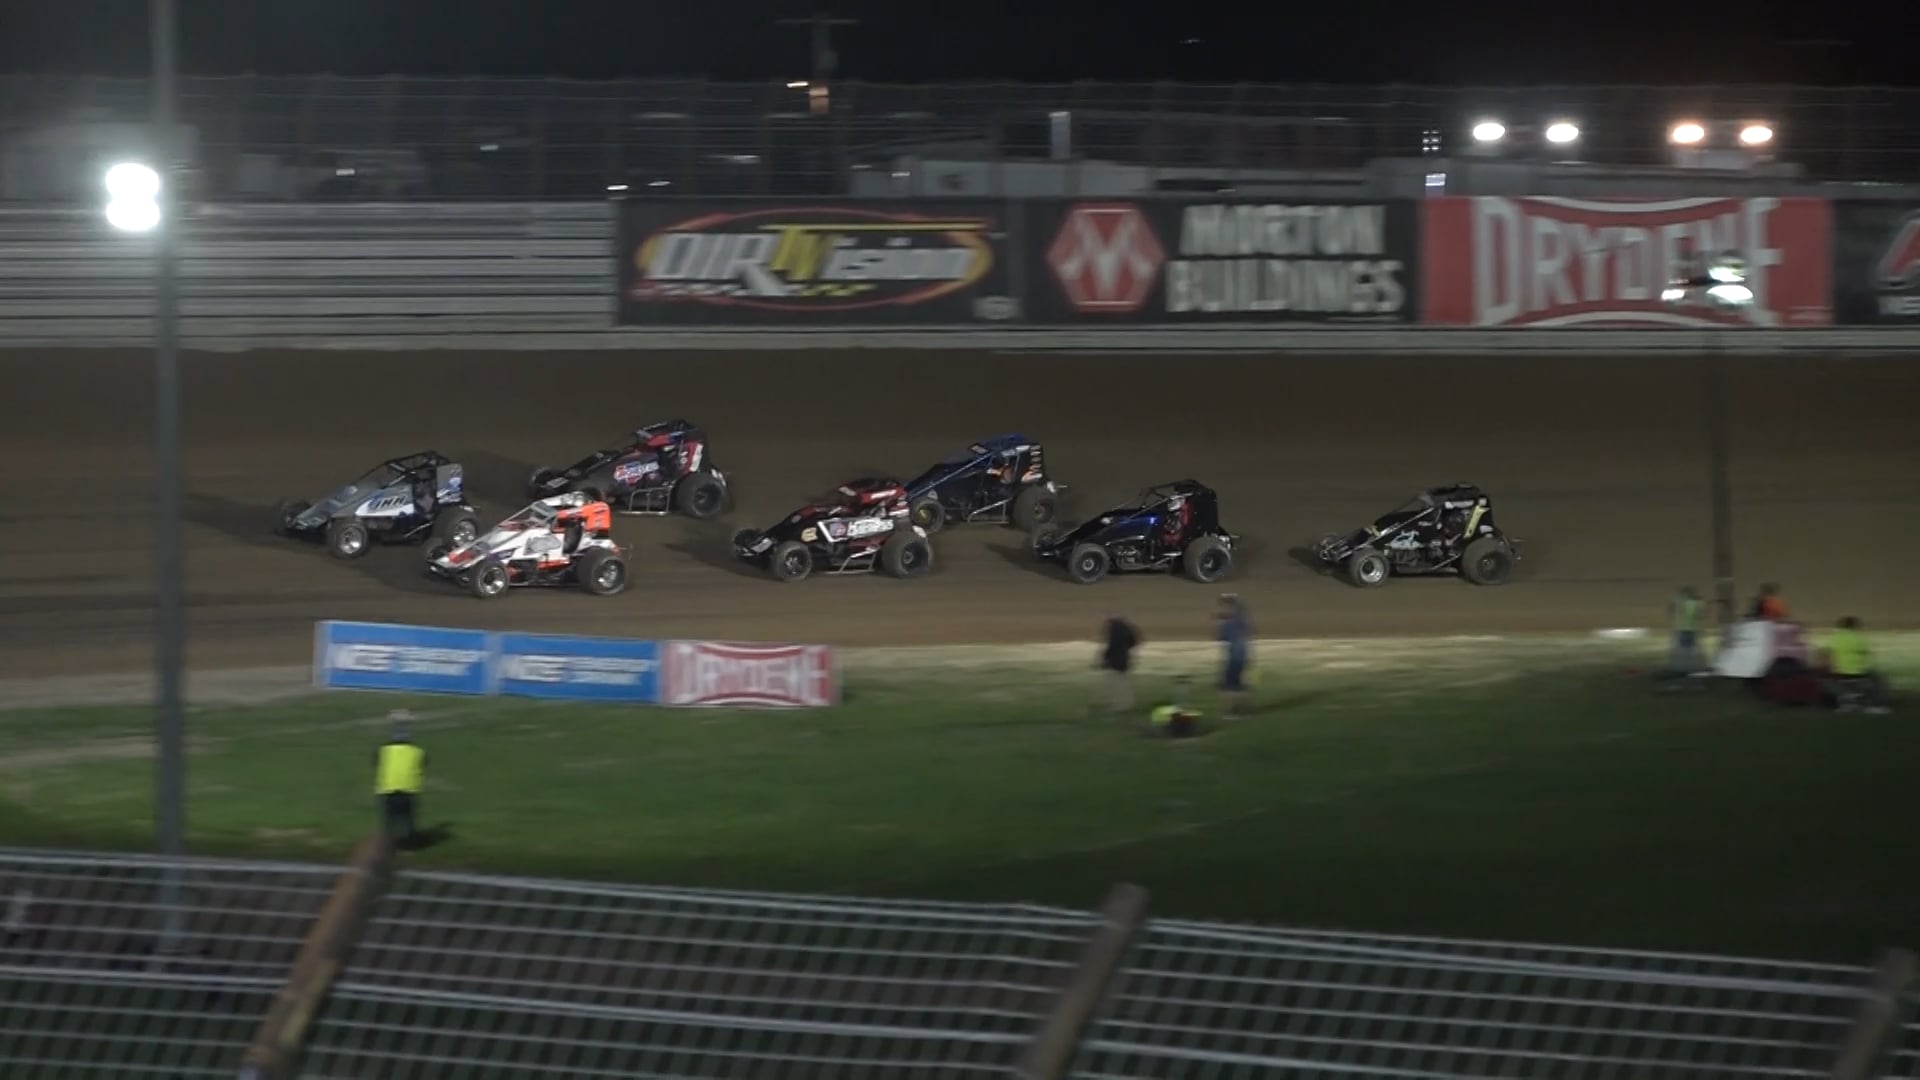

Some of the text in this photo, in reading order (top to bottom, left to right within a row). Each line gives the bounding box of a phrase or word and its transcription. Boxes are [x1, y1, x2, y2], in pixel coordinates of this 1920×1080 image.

[1180, 204, 1386, 255] MORTON
[1166, 259, 1404, 313] BUILDINGS
[1472, 196, 1783, 328] DRYDENE
